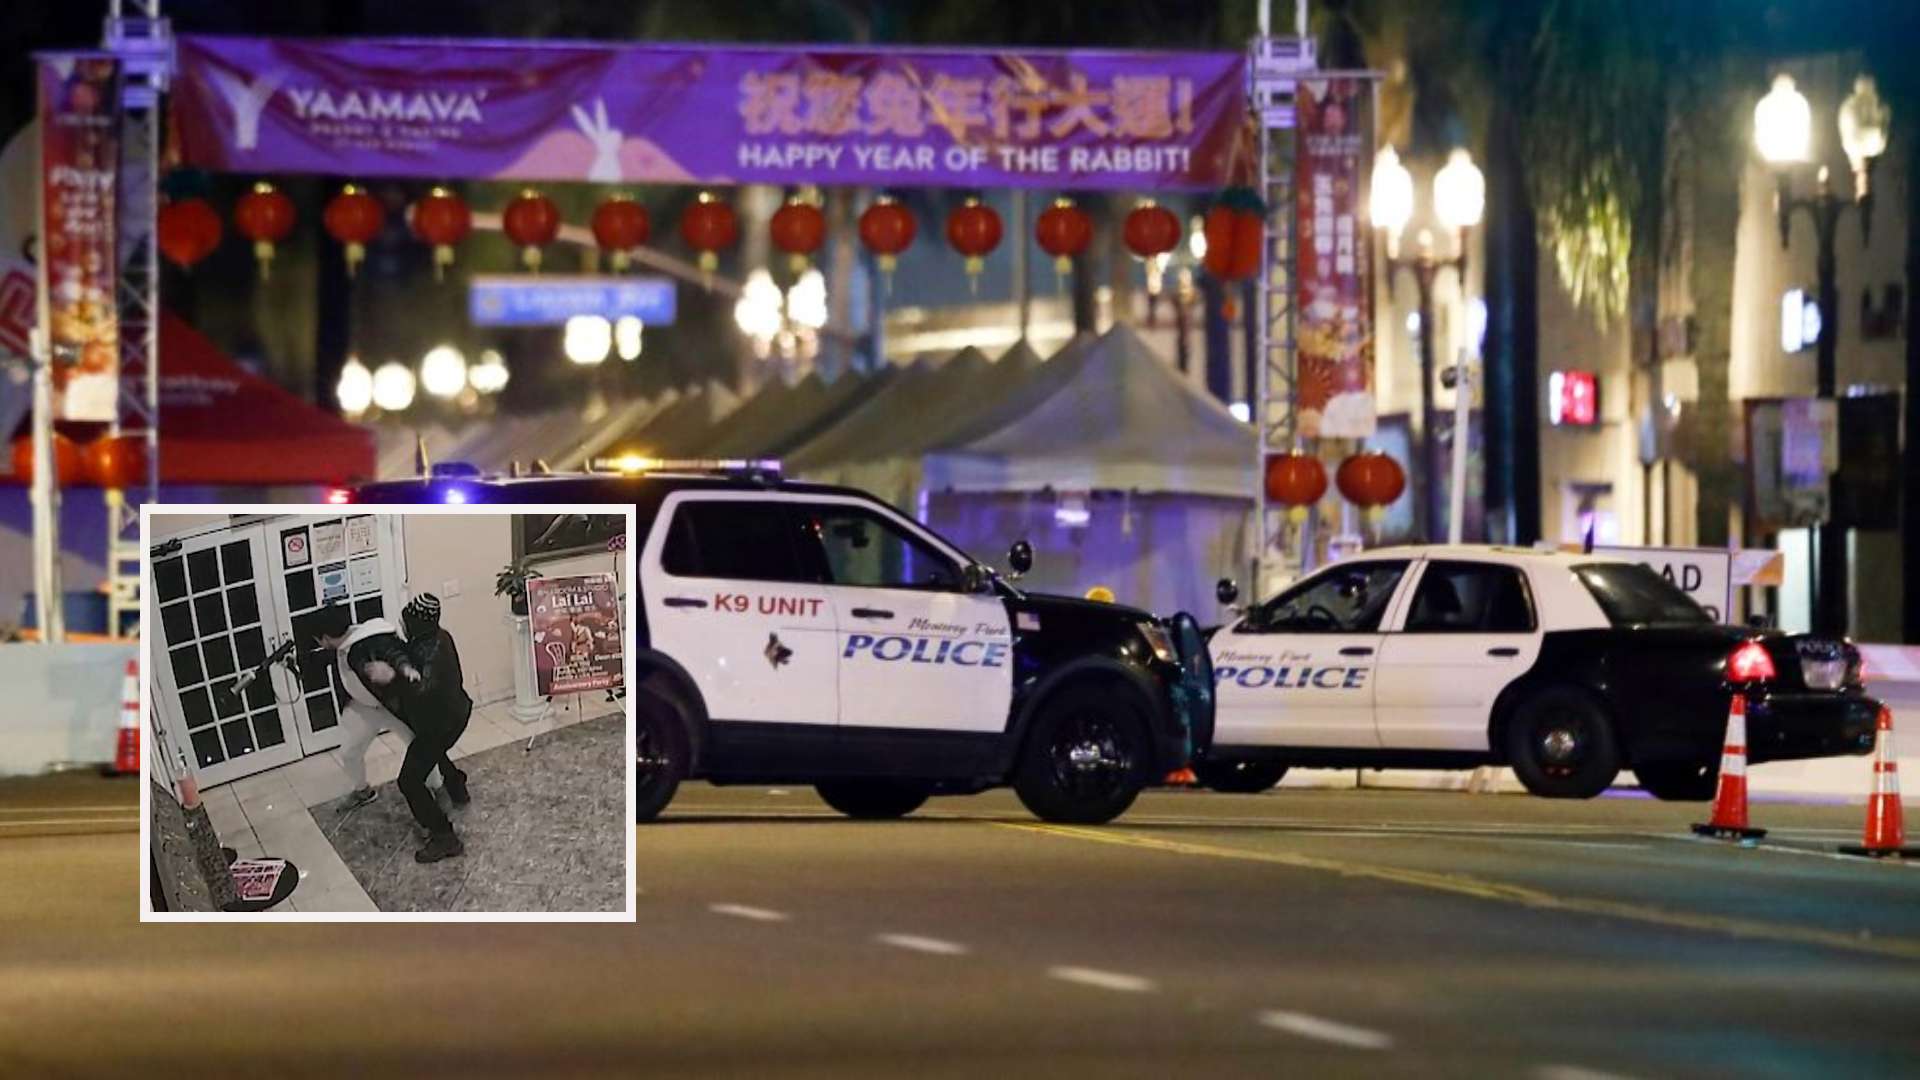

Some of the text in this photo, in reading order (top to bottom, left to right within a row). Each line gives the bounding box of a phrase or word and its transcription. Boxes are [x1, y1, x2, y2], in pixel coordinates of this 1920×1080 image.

[737, 143, 1190, 173] HAPPY YEAR OF THE RABBIT!
[1662, 563, 1702, 592] AD
[551, 591, 594, 608] Lai Lai
[714, 593, 824, 616] K9 UNIT
[843, 634, 1009, 668] POLICE
[1214, 666, 1369, 688] POLICE
